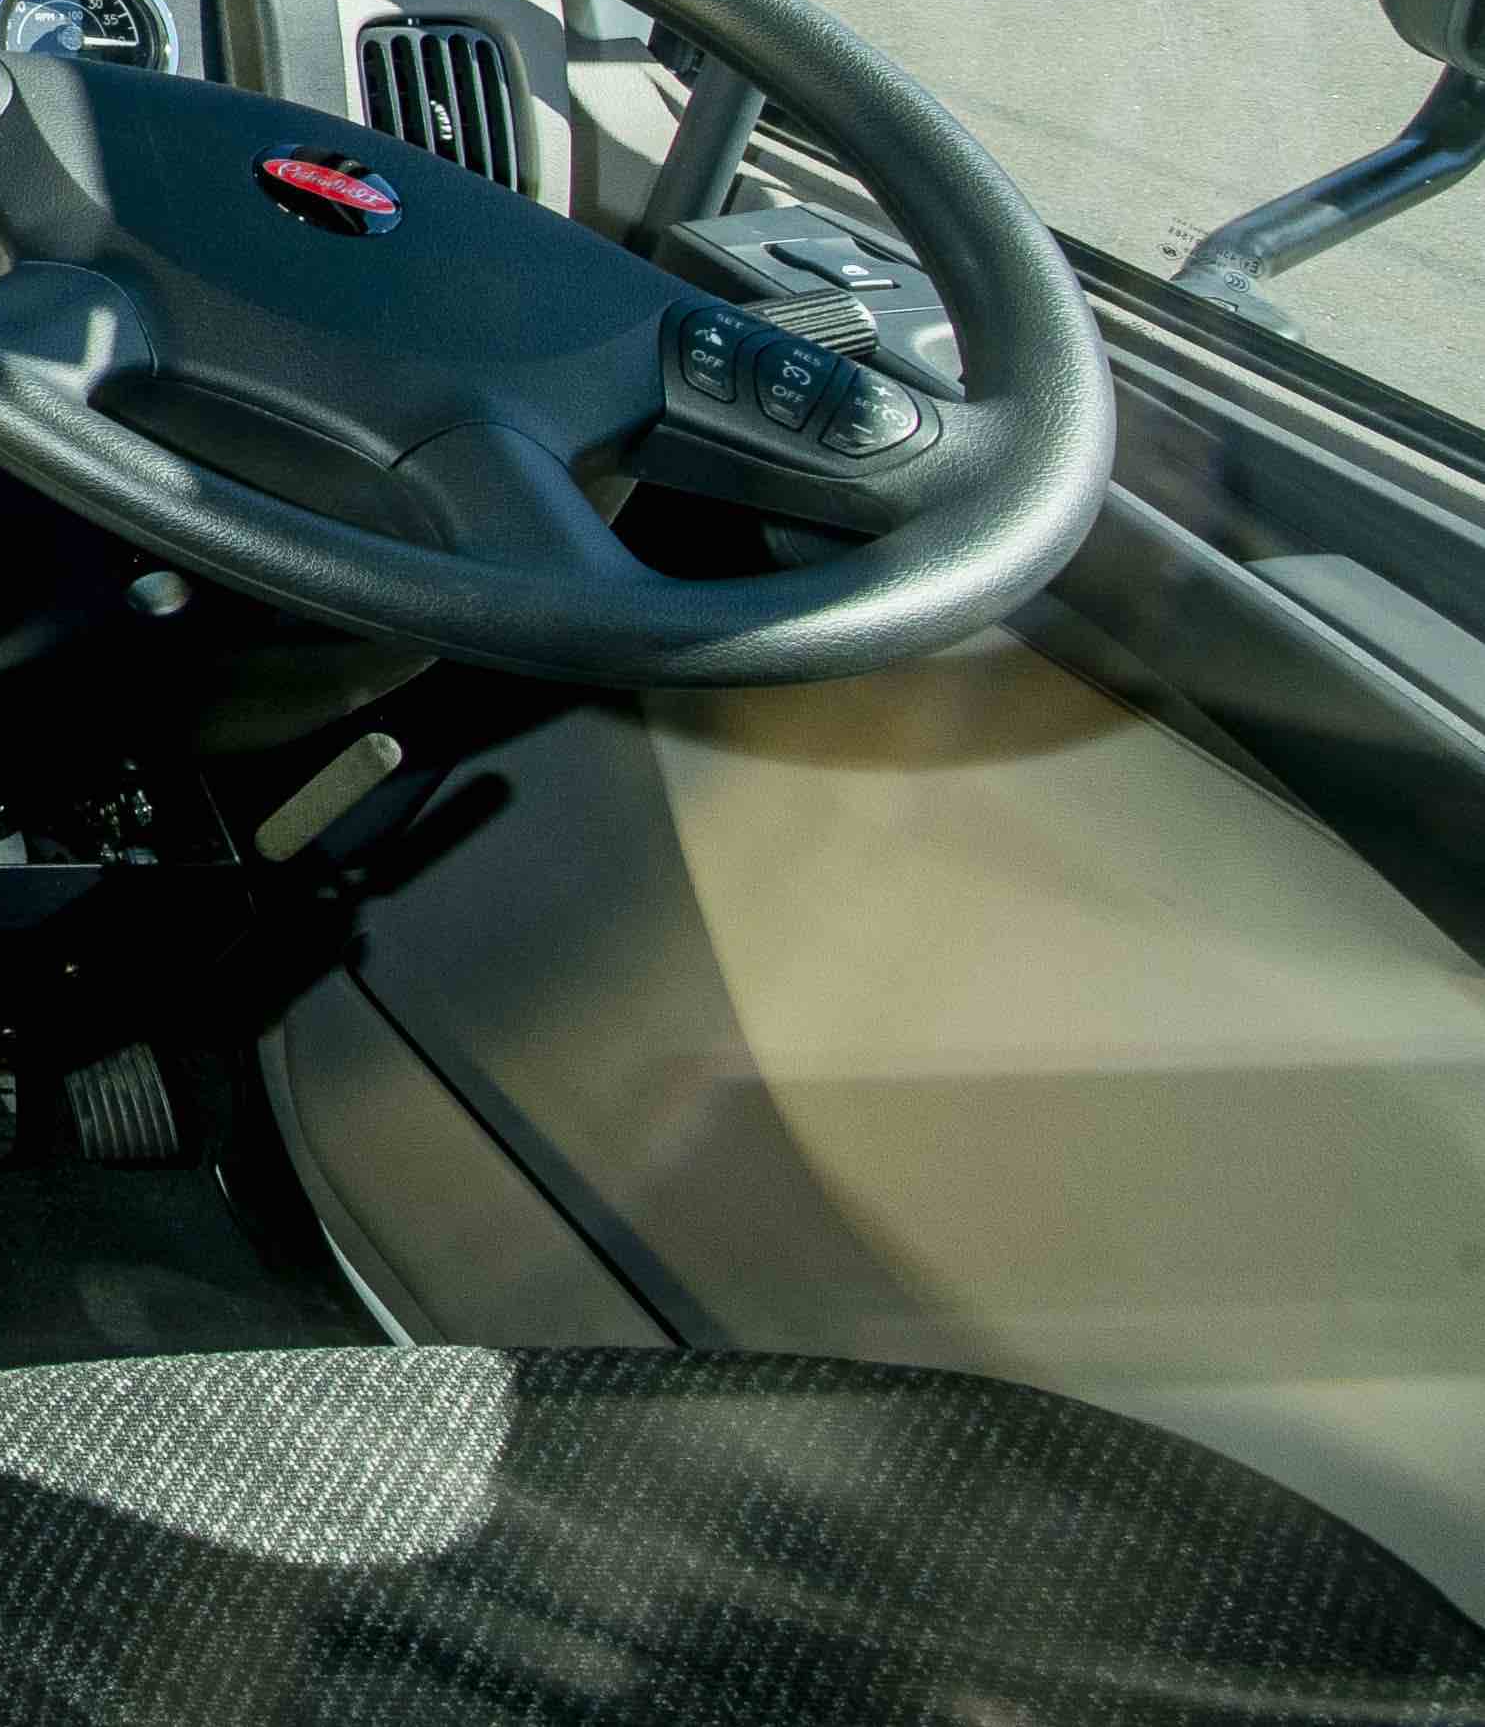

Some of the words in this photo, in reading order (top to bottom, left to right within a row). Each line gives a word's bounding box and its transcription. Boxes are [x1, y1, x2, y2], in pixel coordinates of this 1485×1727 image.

[88, 0, 103, 10] 30
[103, 14, 119, 25] 35
[691, 349, 724, 369] OFF
[772, 385, 805, 403] OFF
